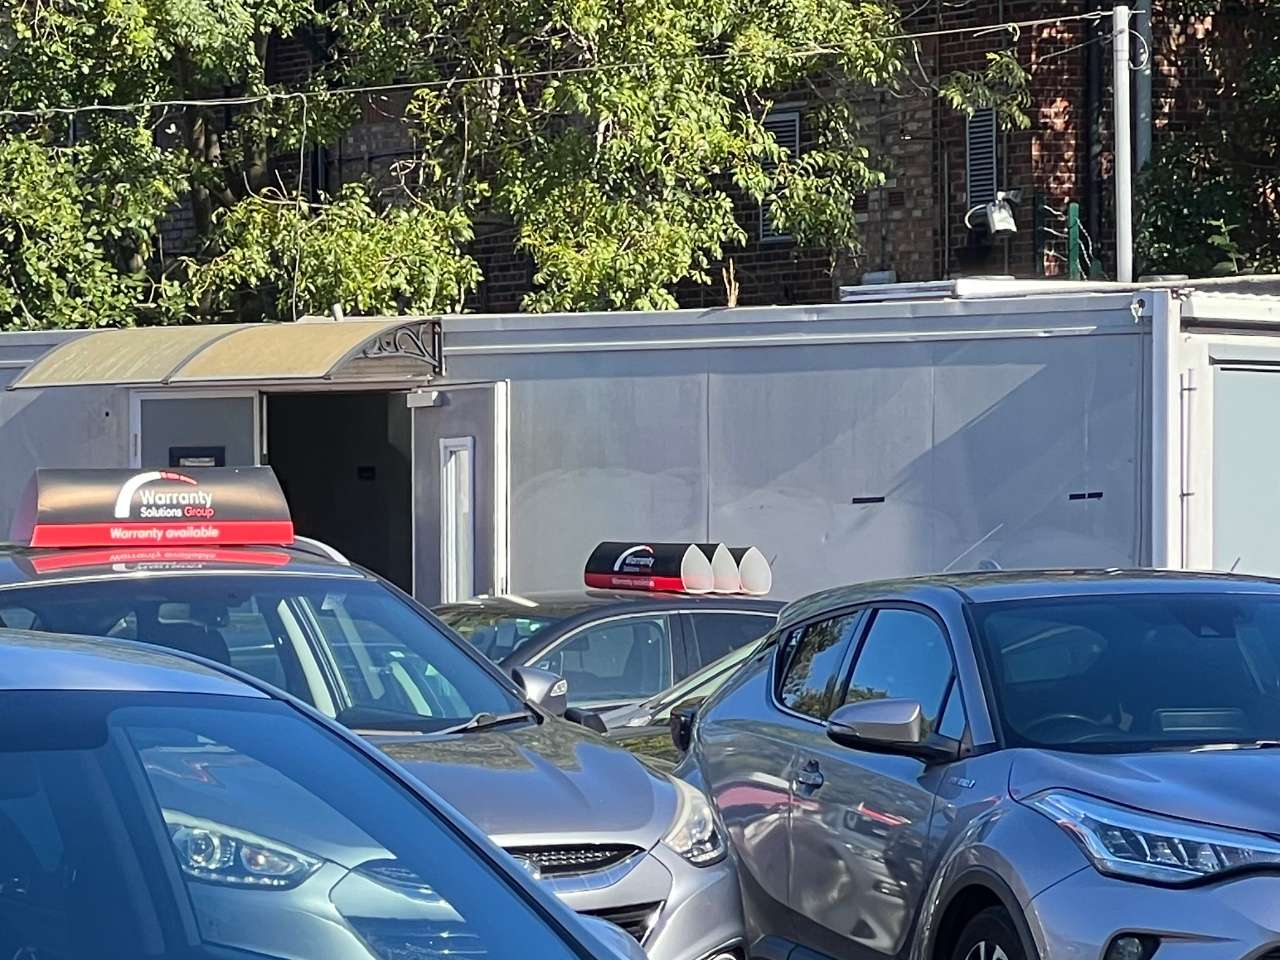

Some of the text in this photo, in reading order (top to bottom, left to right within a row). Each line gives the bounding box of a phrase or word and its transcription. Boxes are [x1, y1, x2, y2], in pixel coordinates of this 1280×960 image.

[140, 490, 213, 507] Warranty
[140, 507, 214, 519] Solutions Group
[110, 526, 219, 540] Warranty available
